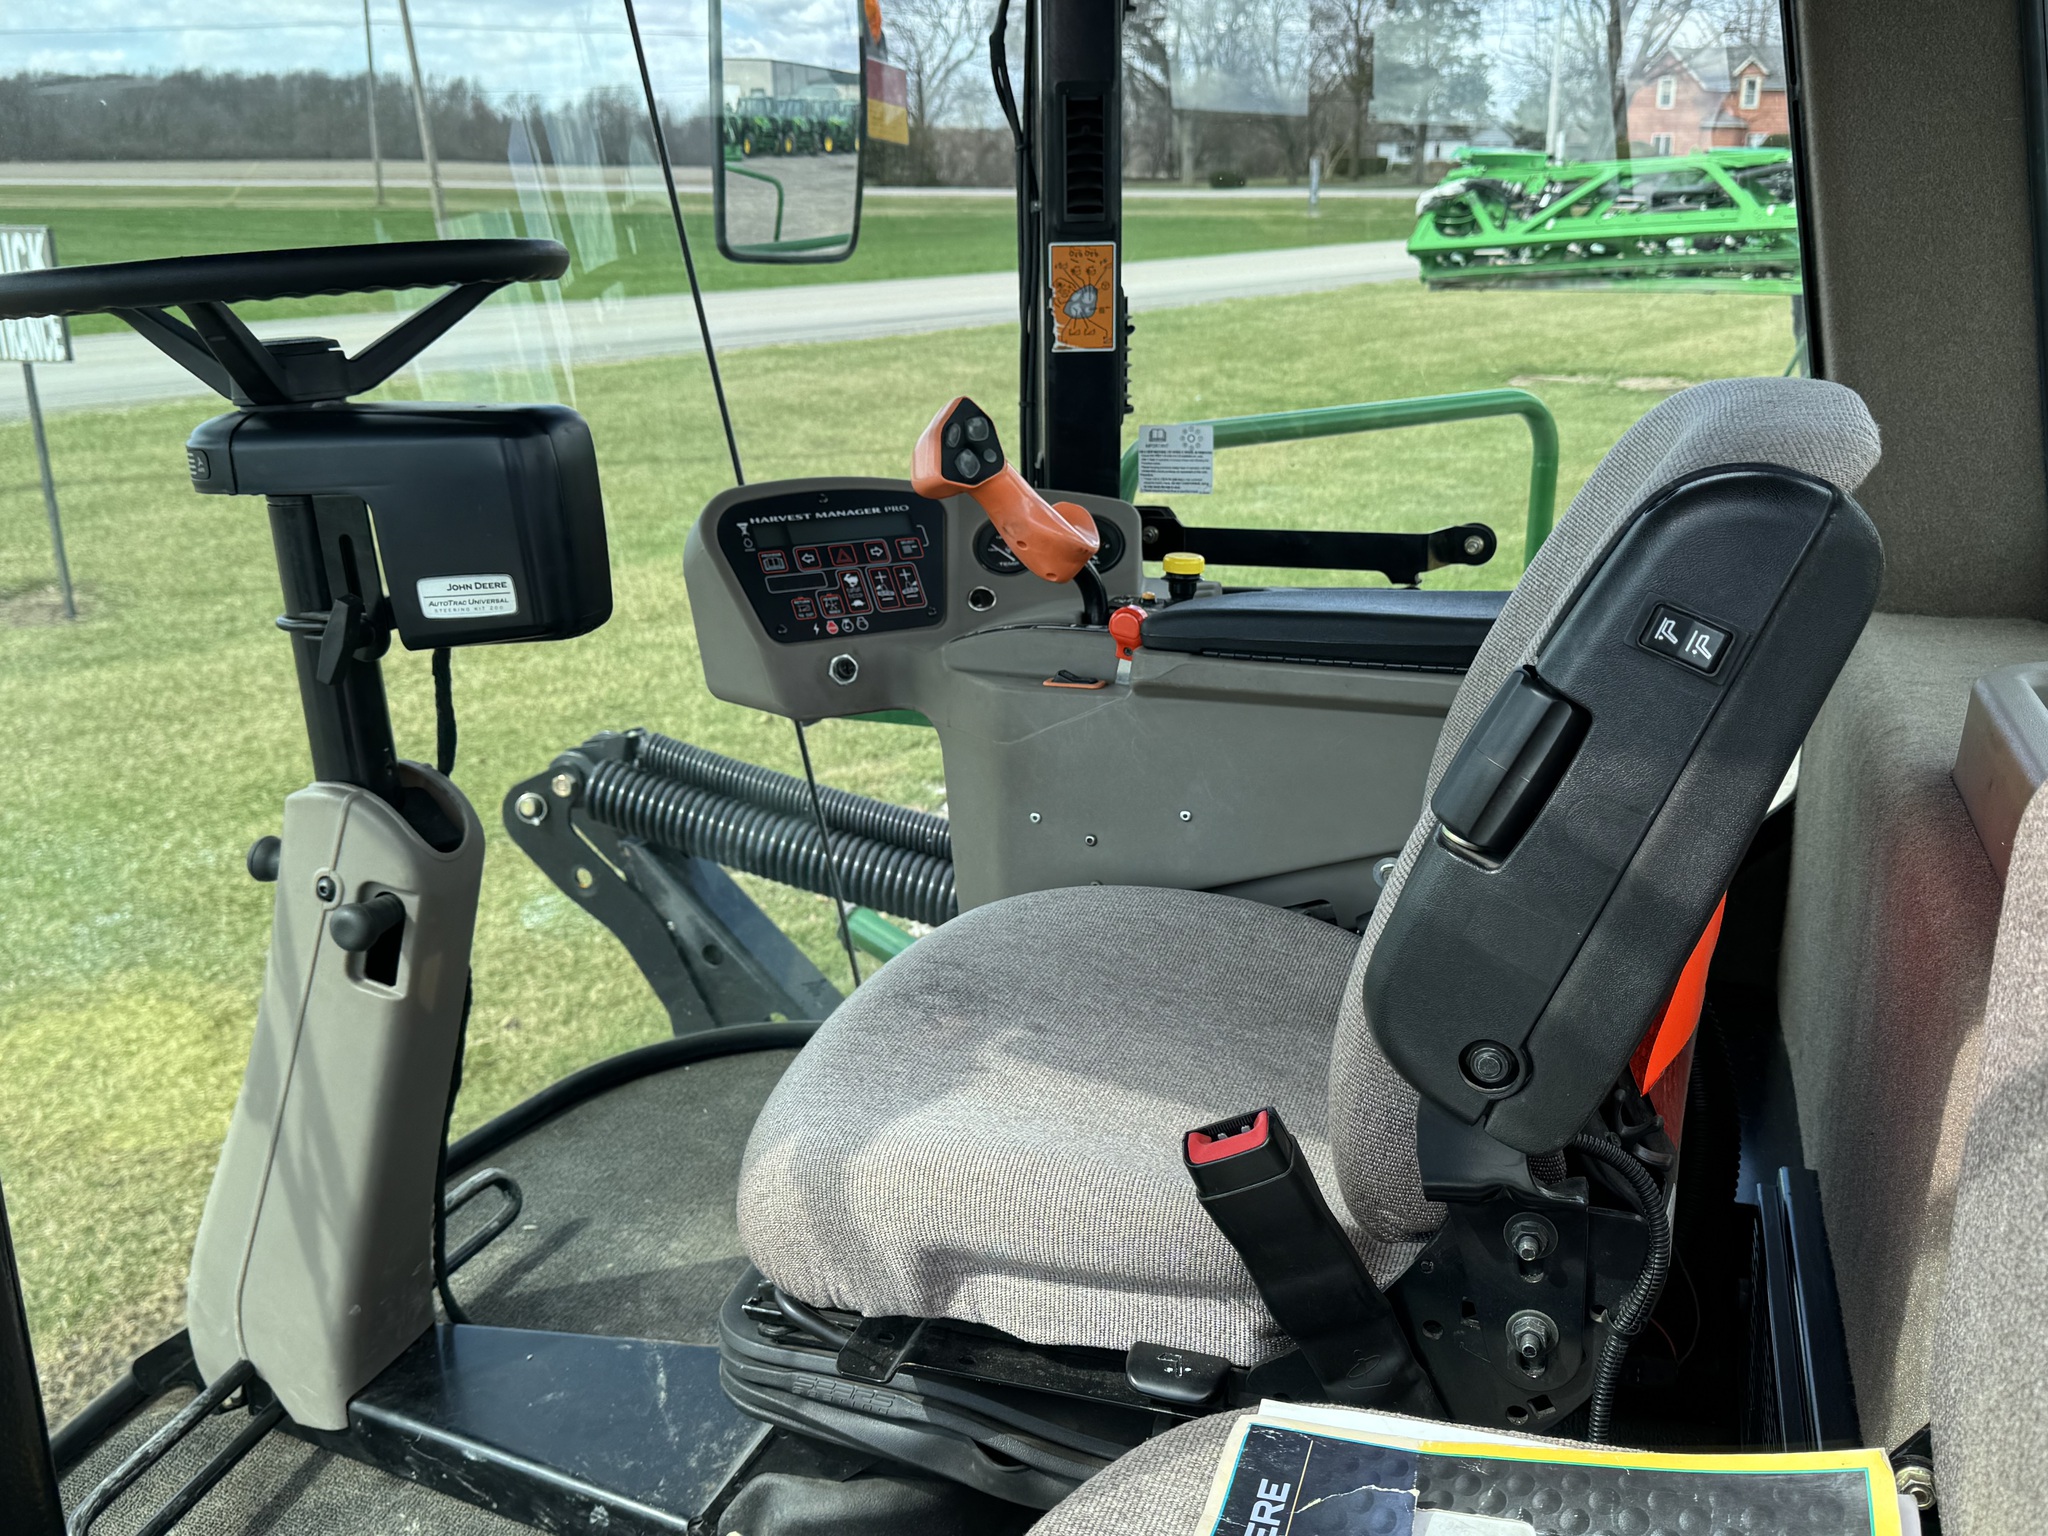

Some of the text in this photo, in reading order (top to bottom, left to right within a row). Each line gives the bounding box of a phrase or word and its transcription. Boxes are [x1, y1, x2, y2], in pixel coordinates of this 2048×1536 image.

[749, 504, 910, 524] HARVEST MANAGER PRO
[446, 581, 507, 591] JOHN DEERE
[468, 597, 509, 605] UNIVERSAL
